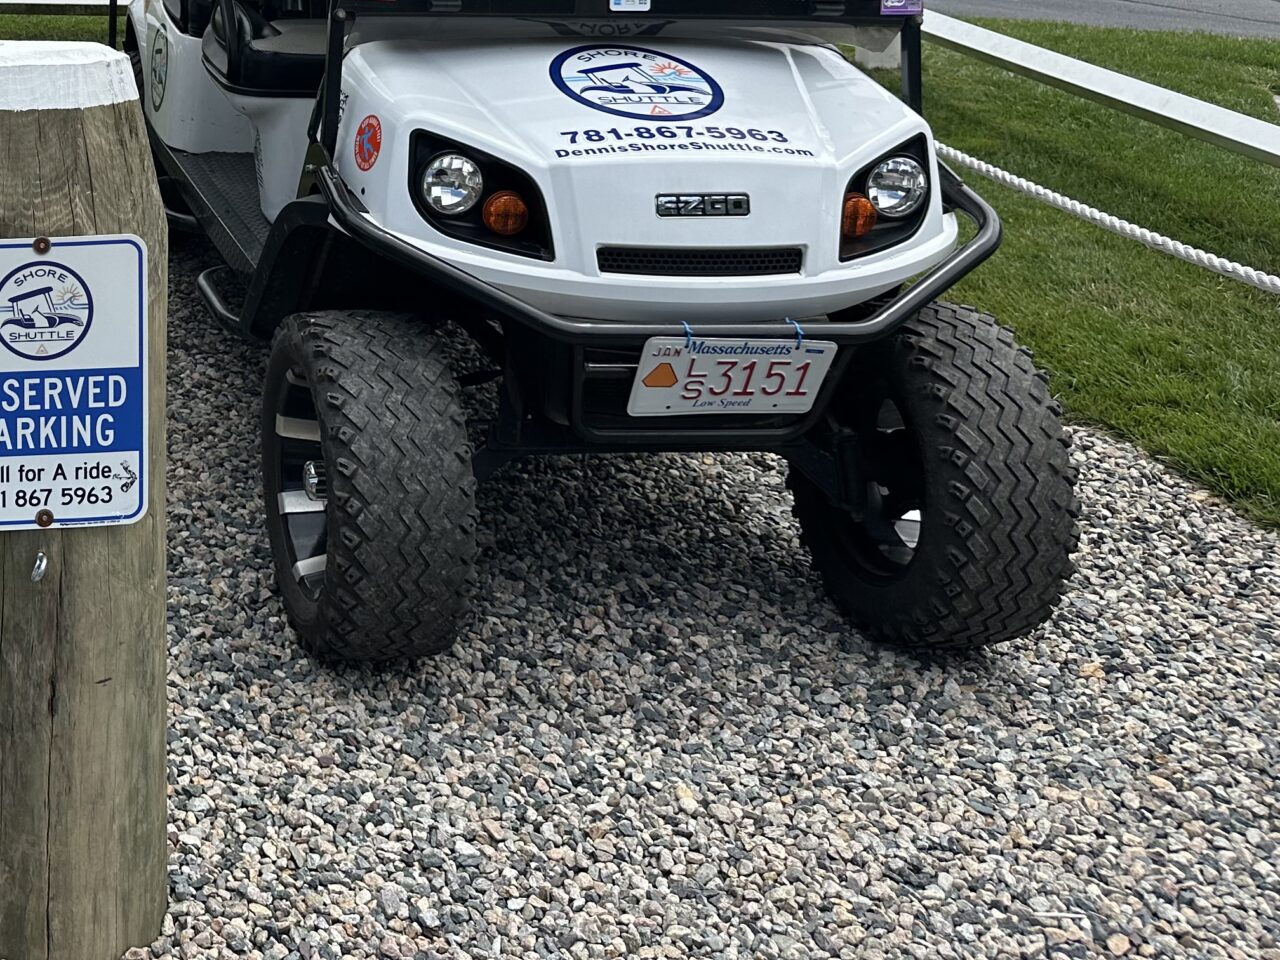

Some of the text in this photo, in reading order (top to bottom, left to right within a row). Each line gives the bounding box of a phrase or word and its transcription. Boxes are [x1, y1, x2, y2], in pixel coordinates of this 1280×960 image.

[578, 50, 657, 62] SHORE
[598, 96, 702, 104] SHUTTLE
[561, 126, 788, 145] 781-867-5963
[555, 143, 815, 158] DennisShoreShuttle.com
[658, 195, 749, 216] EZGO
[13, 268, 68, 287] SHORE
[9, 330, 75, 341] SHUTTLE
[652, 346, 683, 358] JAN
[687, 341, 793, 356] Massachusetts
[692, 398, 752, 409] Low Speed
[18, 464, 45, 483] for
[53, 463, 67, 480] A
[75, 461, 112, 480] ride
[15, 488, 52, 507] 867
[61, 486, 113, 505] 5963
